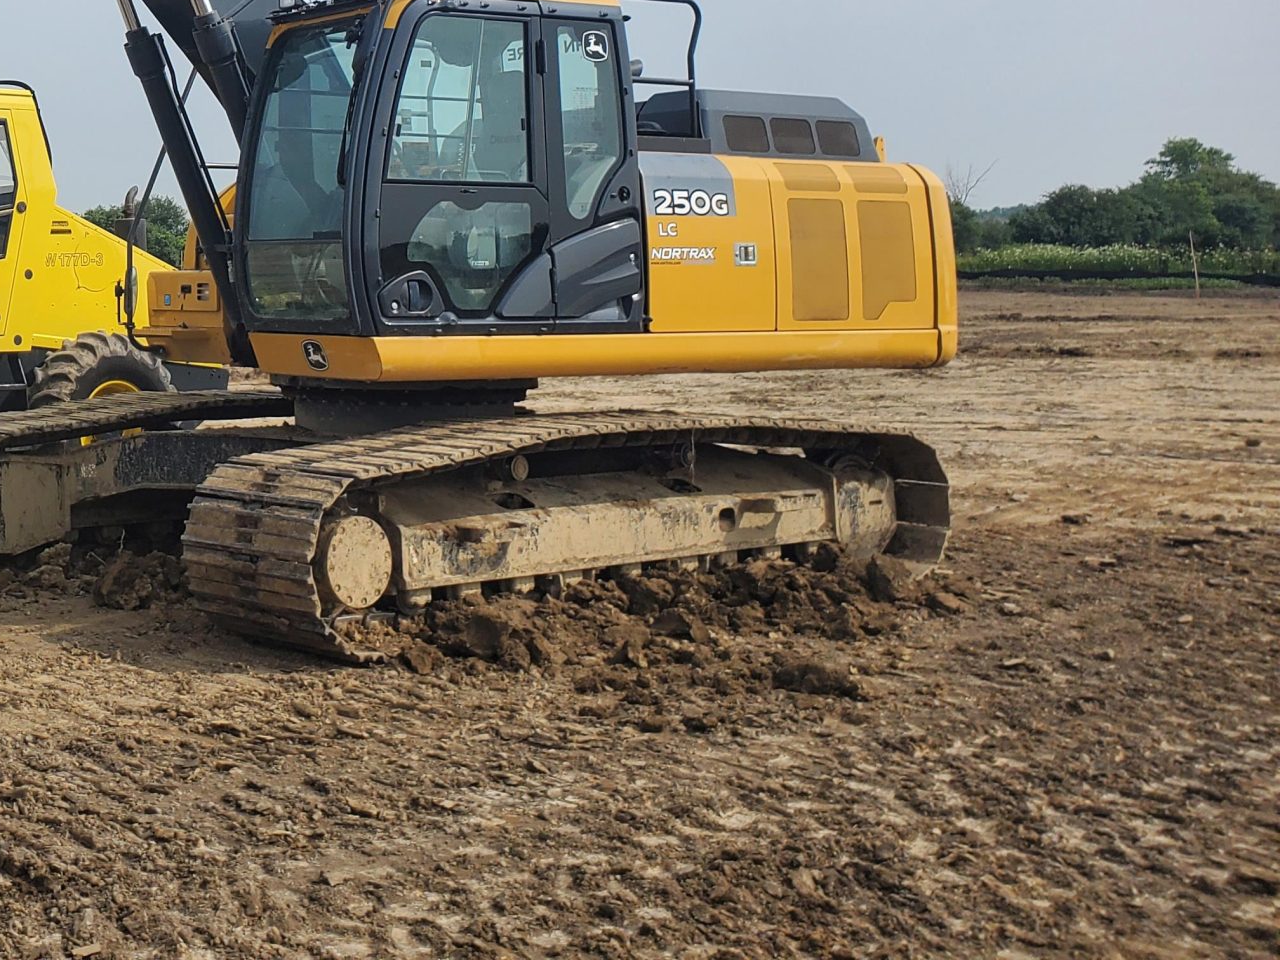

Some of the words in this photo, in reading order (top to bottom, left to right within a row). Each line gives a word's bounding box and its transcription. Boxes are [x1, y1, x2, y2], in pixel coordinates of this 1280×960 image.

[653, 189, 729, 215] 250G
[659, 222, 677, 237] LC
[58, 252, 104, 267] 177D-3
[651, 247, 716, 260] NORTRAX
